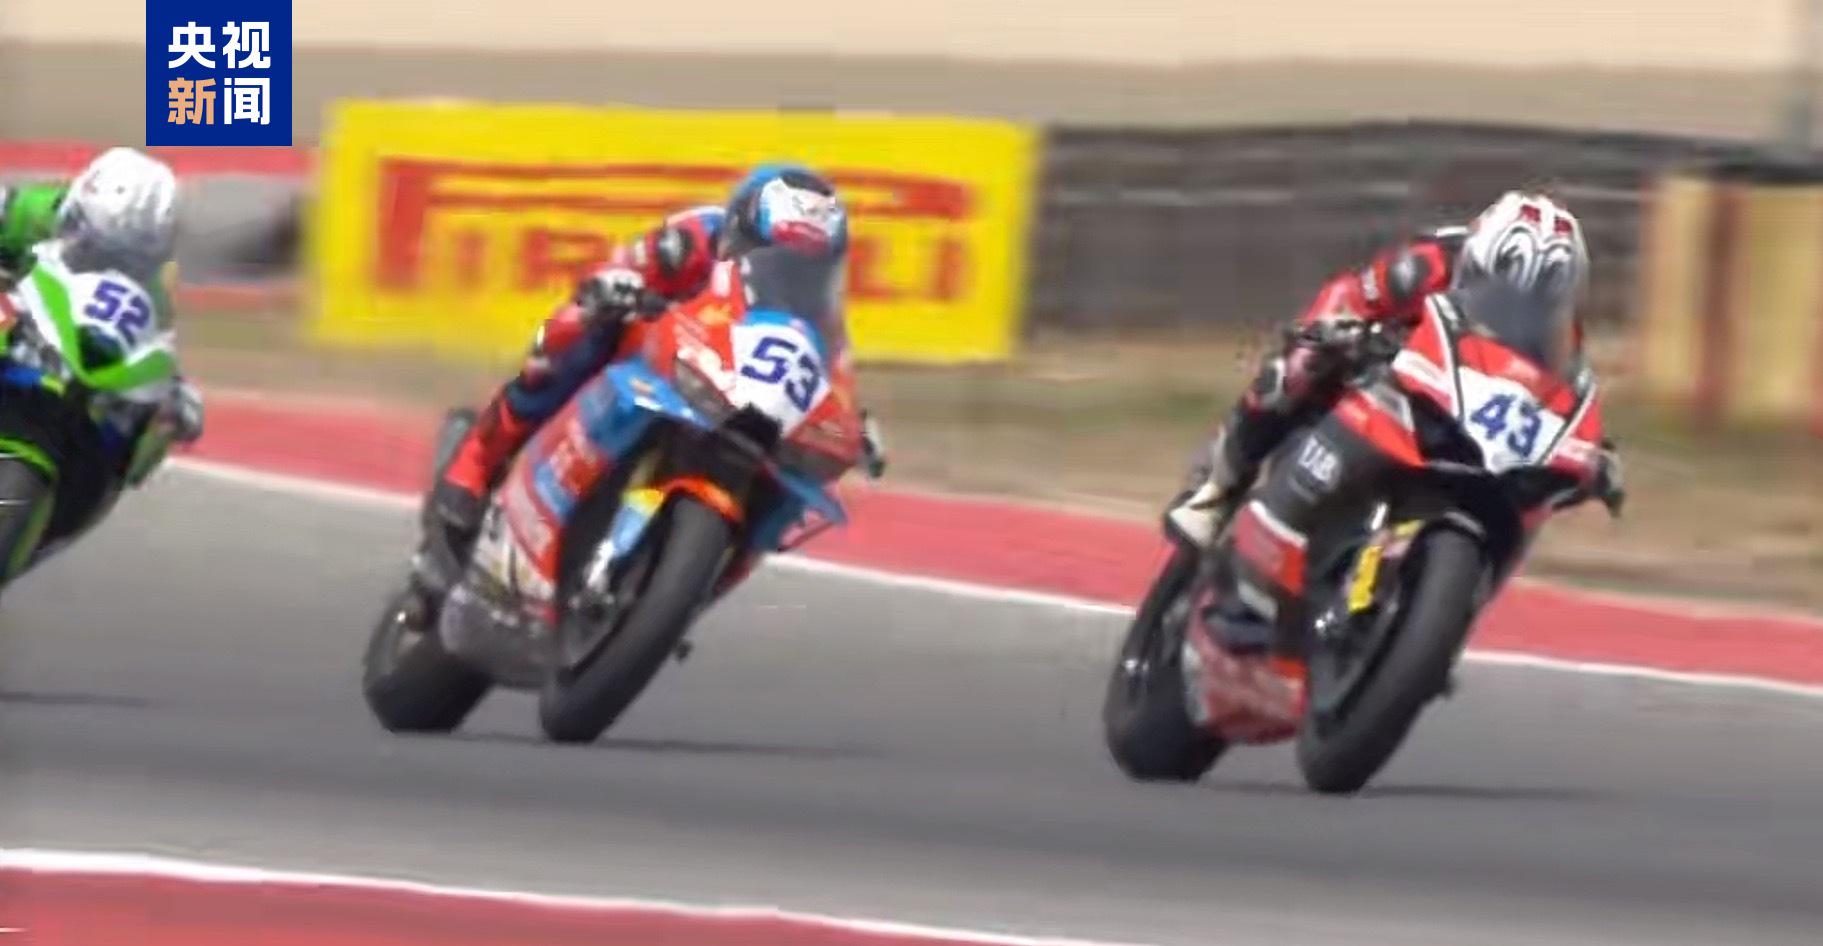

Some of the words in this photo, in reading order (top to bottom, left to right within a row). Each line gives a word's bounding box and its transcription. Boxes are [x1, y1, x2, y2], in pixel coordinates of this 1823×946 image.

[375, 157, 975, 303] PIRLI
[85, 280, 150, 346] 52
[741, 336, 820, 412] 53
[1470, 393, 1542, 457] 43
